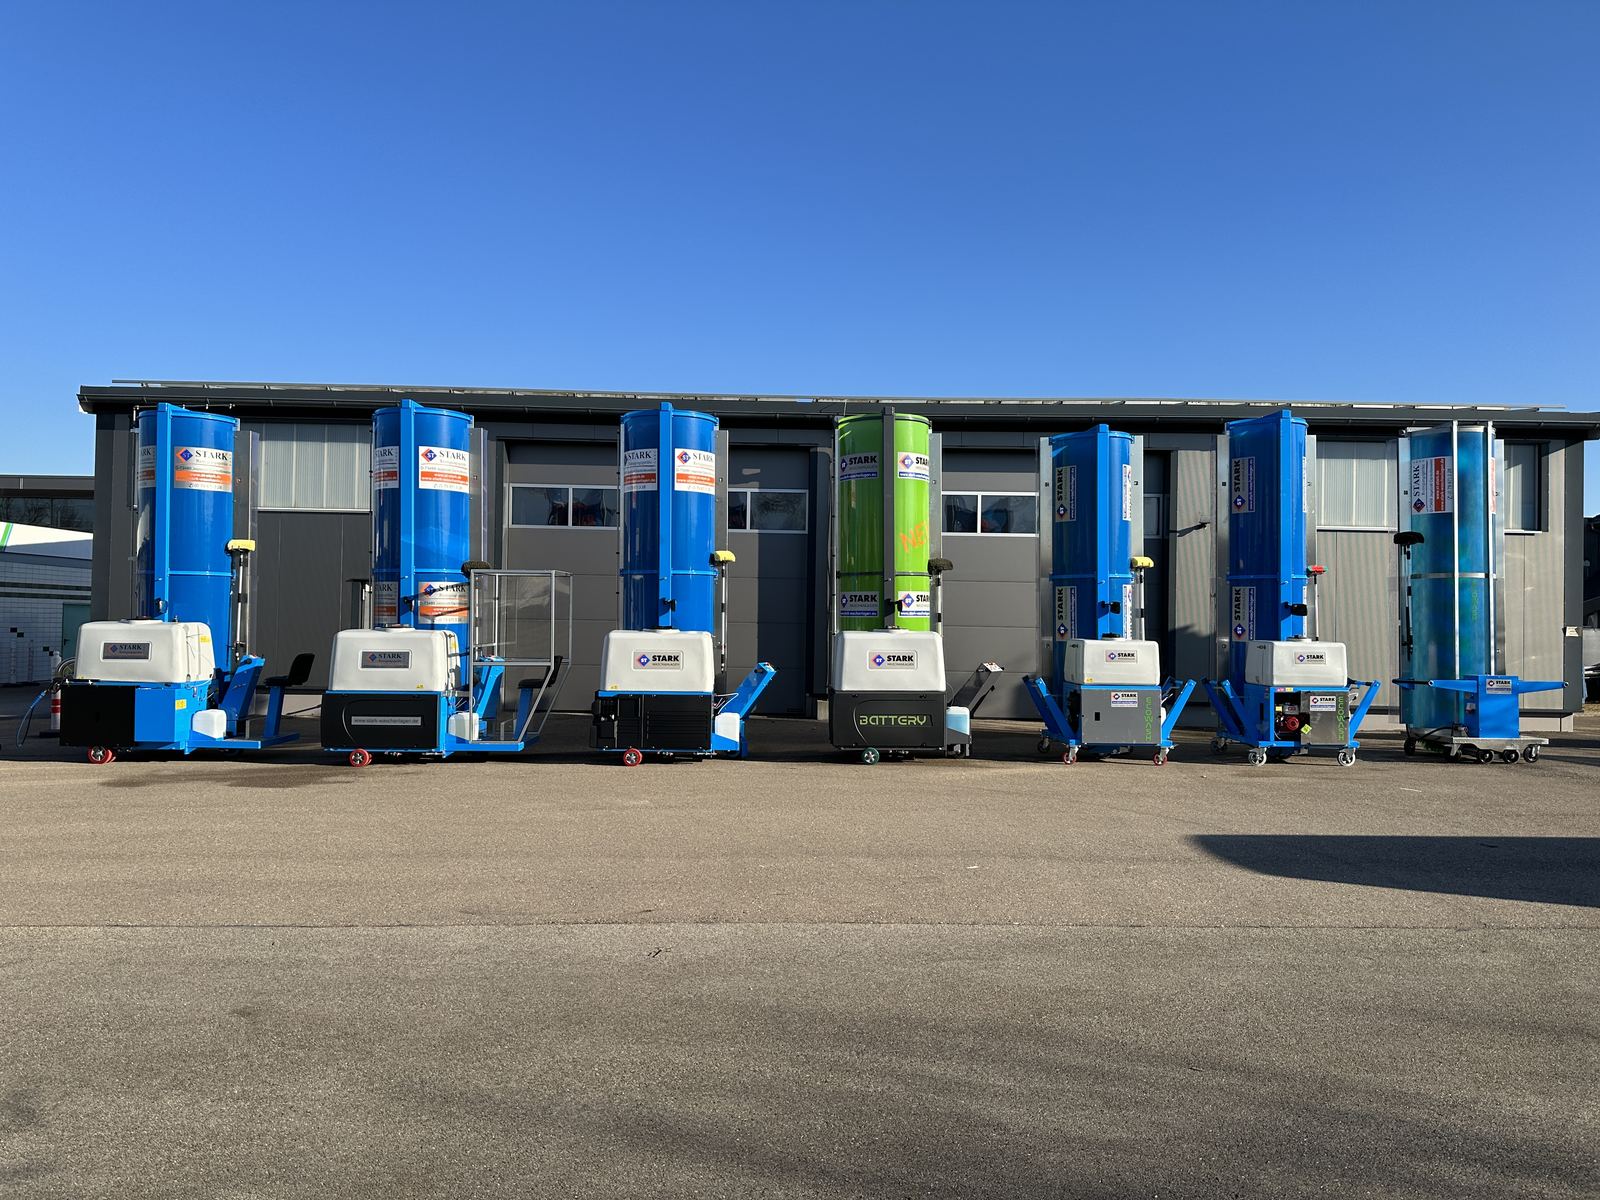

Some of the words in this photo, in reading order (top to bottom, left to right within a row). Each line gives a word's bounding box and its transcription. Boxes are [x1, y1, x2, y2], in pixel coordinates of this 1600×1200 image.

[196, 450, 228, 461] STARK
[439, 450, 466, 461] STARK
[628, 451, 652, 460] STARK
[849, 456, 877, 465] STARK
[860, 715, 926, 725] BATTERY
